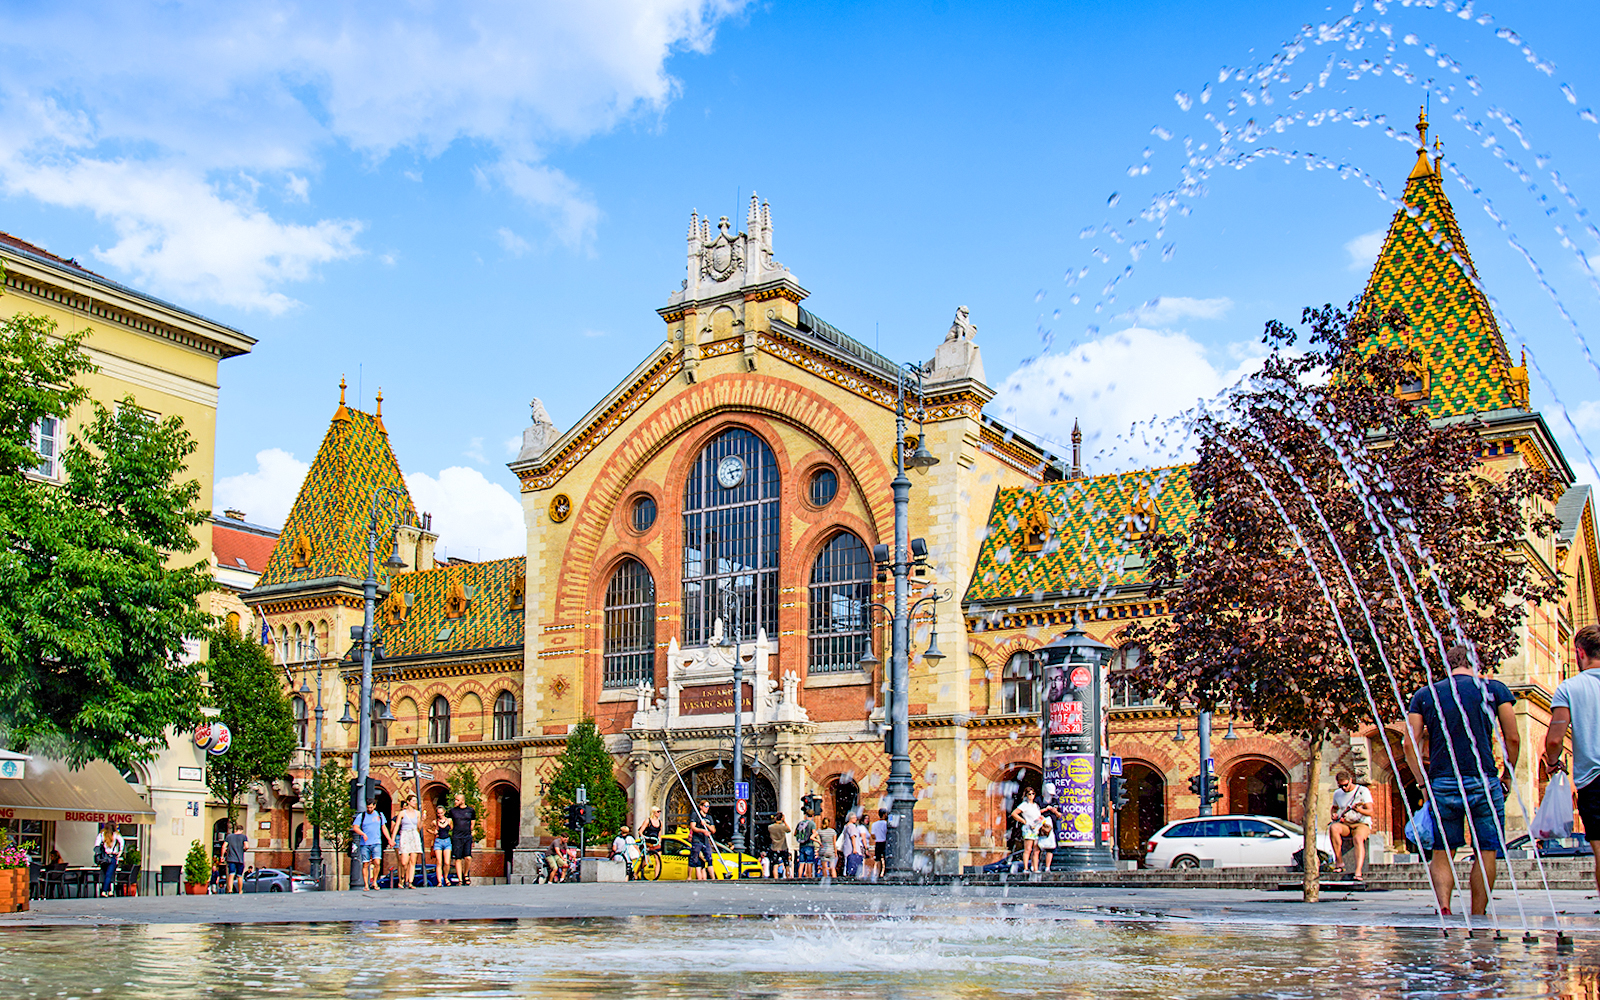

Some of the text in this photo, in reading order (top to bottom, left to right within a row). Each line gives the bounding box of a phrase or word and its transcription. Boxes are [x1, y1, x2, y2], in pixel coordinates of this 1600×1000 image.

[683, 698, 752, 710] VÁSÁRCSAROK
[1044, 771, 1060, 779] LANA
[1055, 779, 1072, 787] REY
[1063, 788, 1094, 796] PAROV
[1059, 796, 1093, 804] STELAR
[1062, 805, 1094, 813] KOOKS
[65, 811, 133, 823] BURGER KING
[1058, 831, 1094, 840] COOPER
